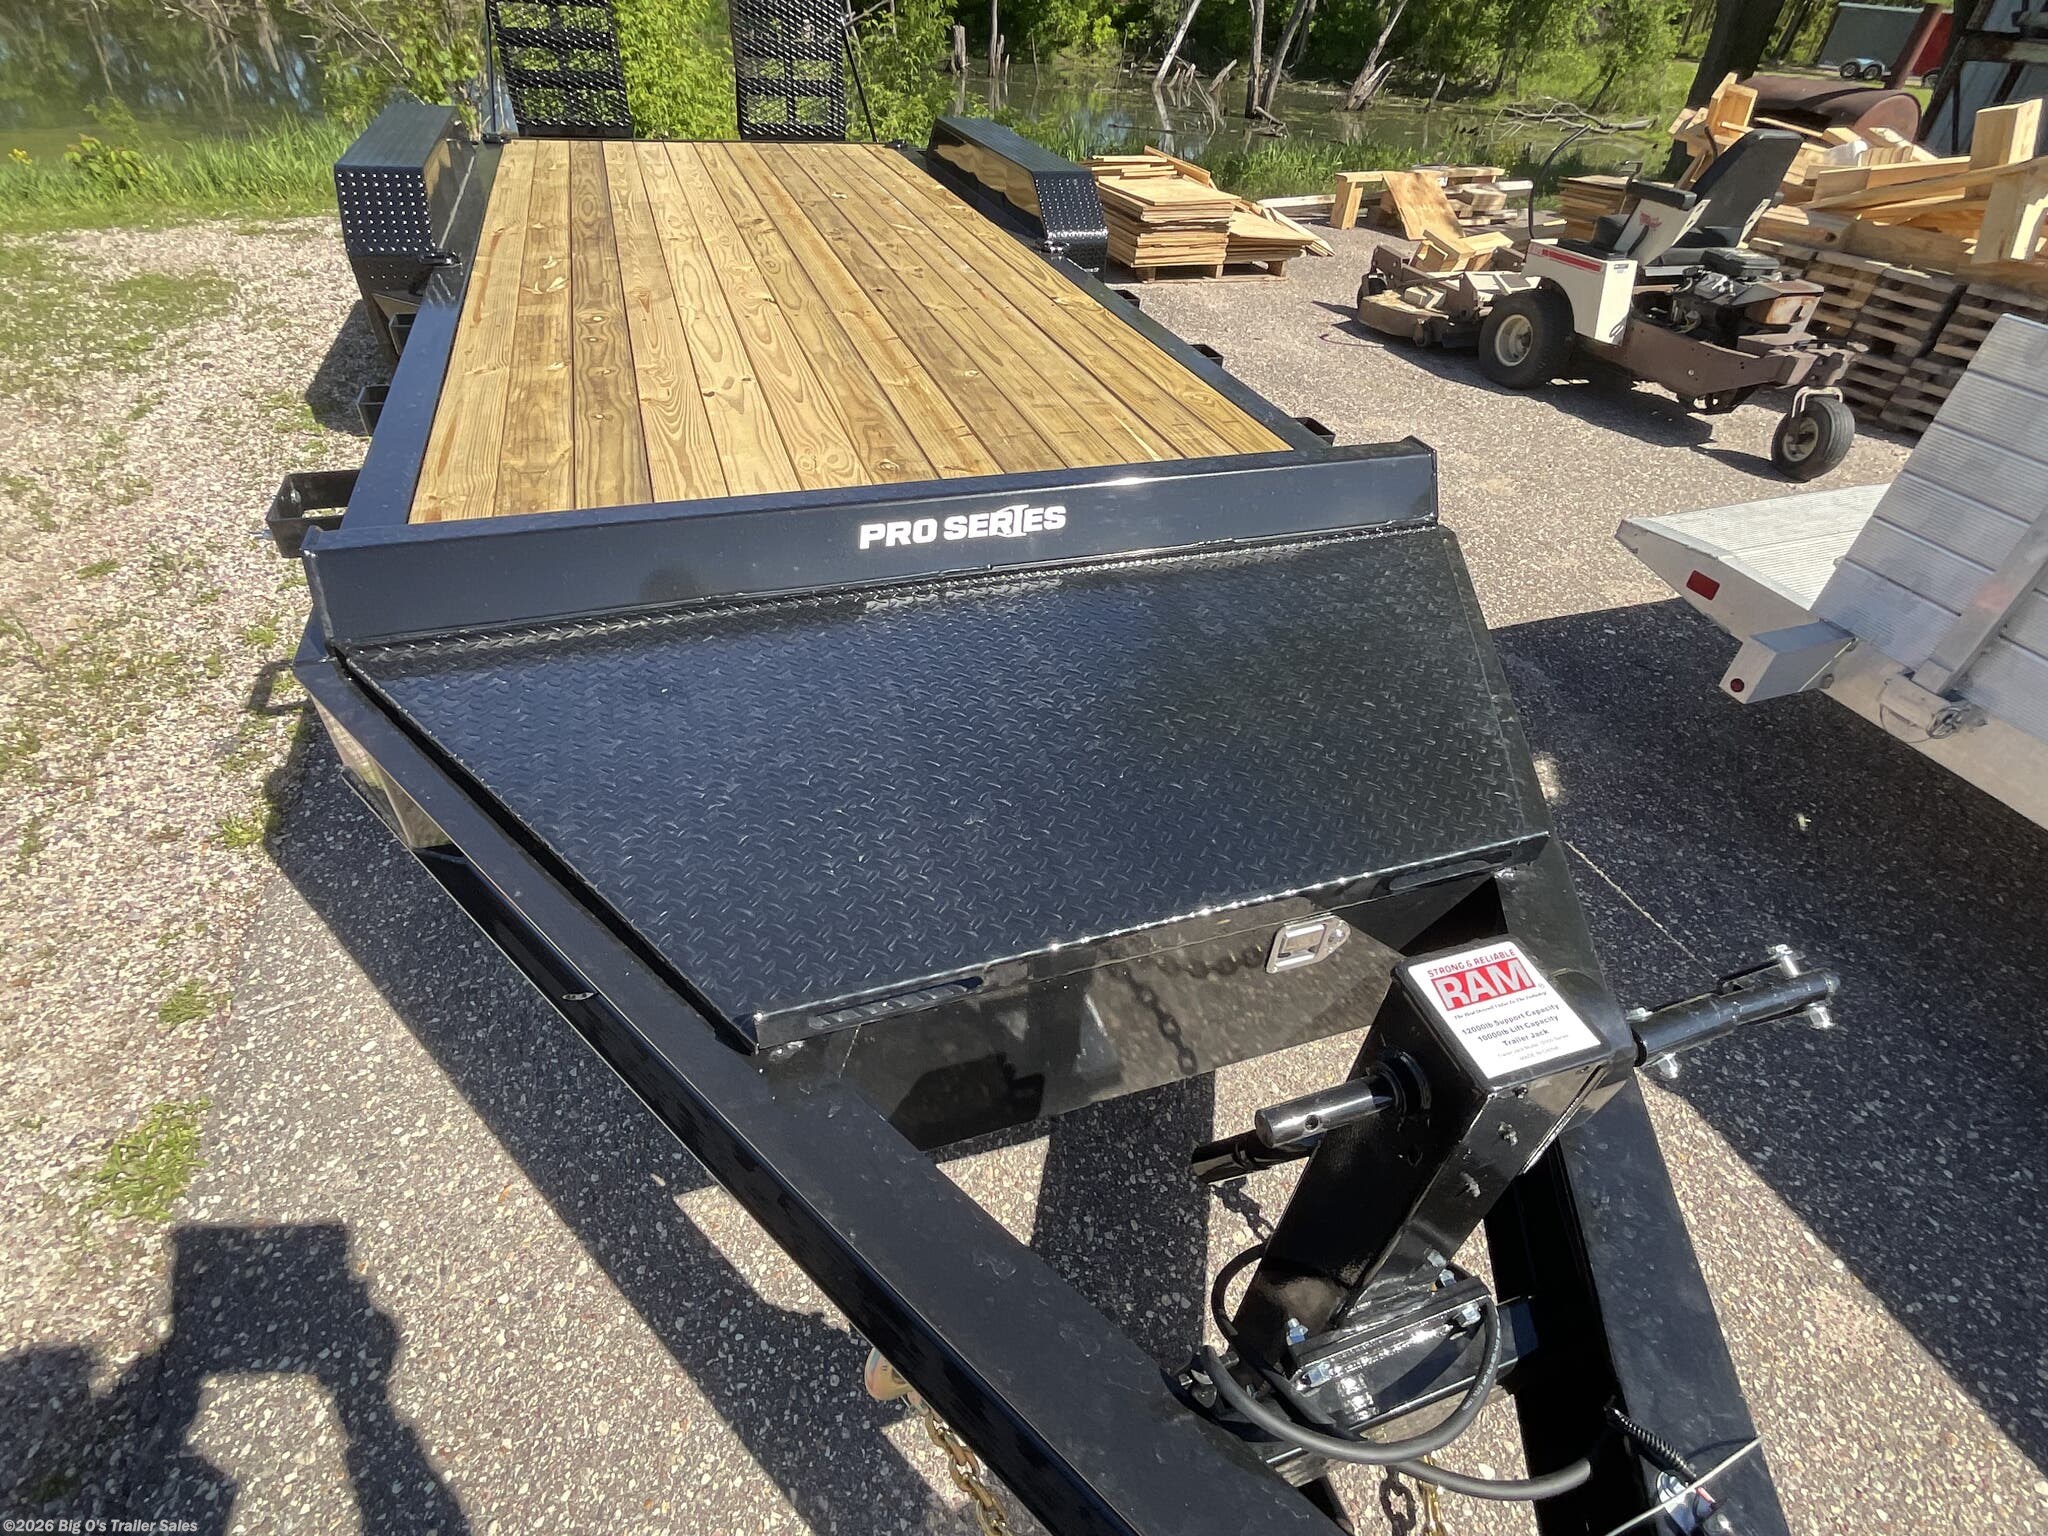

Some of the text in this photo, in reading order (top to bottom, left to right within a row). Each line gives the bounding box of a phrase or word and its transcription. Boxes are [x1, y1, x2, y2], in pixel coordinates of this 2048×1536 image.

[860, 504, 1066, 549] PRO SERIES
[1427, 949, 1516, 978] STRONG & RELIABLE
[1433, 958, 1534, 1009] RAM
[1462, 1003, 1560, 1035] 12000lb Support Capacity
[1477, 1015, 1559, 1042] 10000lb Lift Capacity
[1501, 1035, 1530, 1047] Trailer
[1530, 1028, 1550, 1039] Jack
